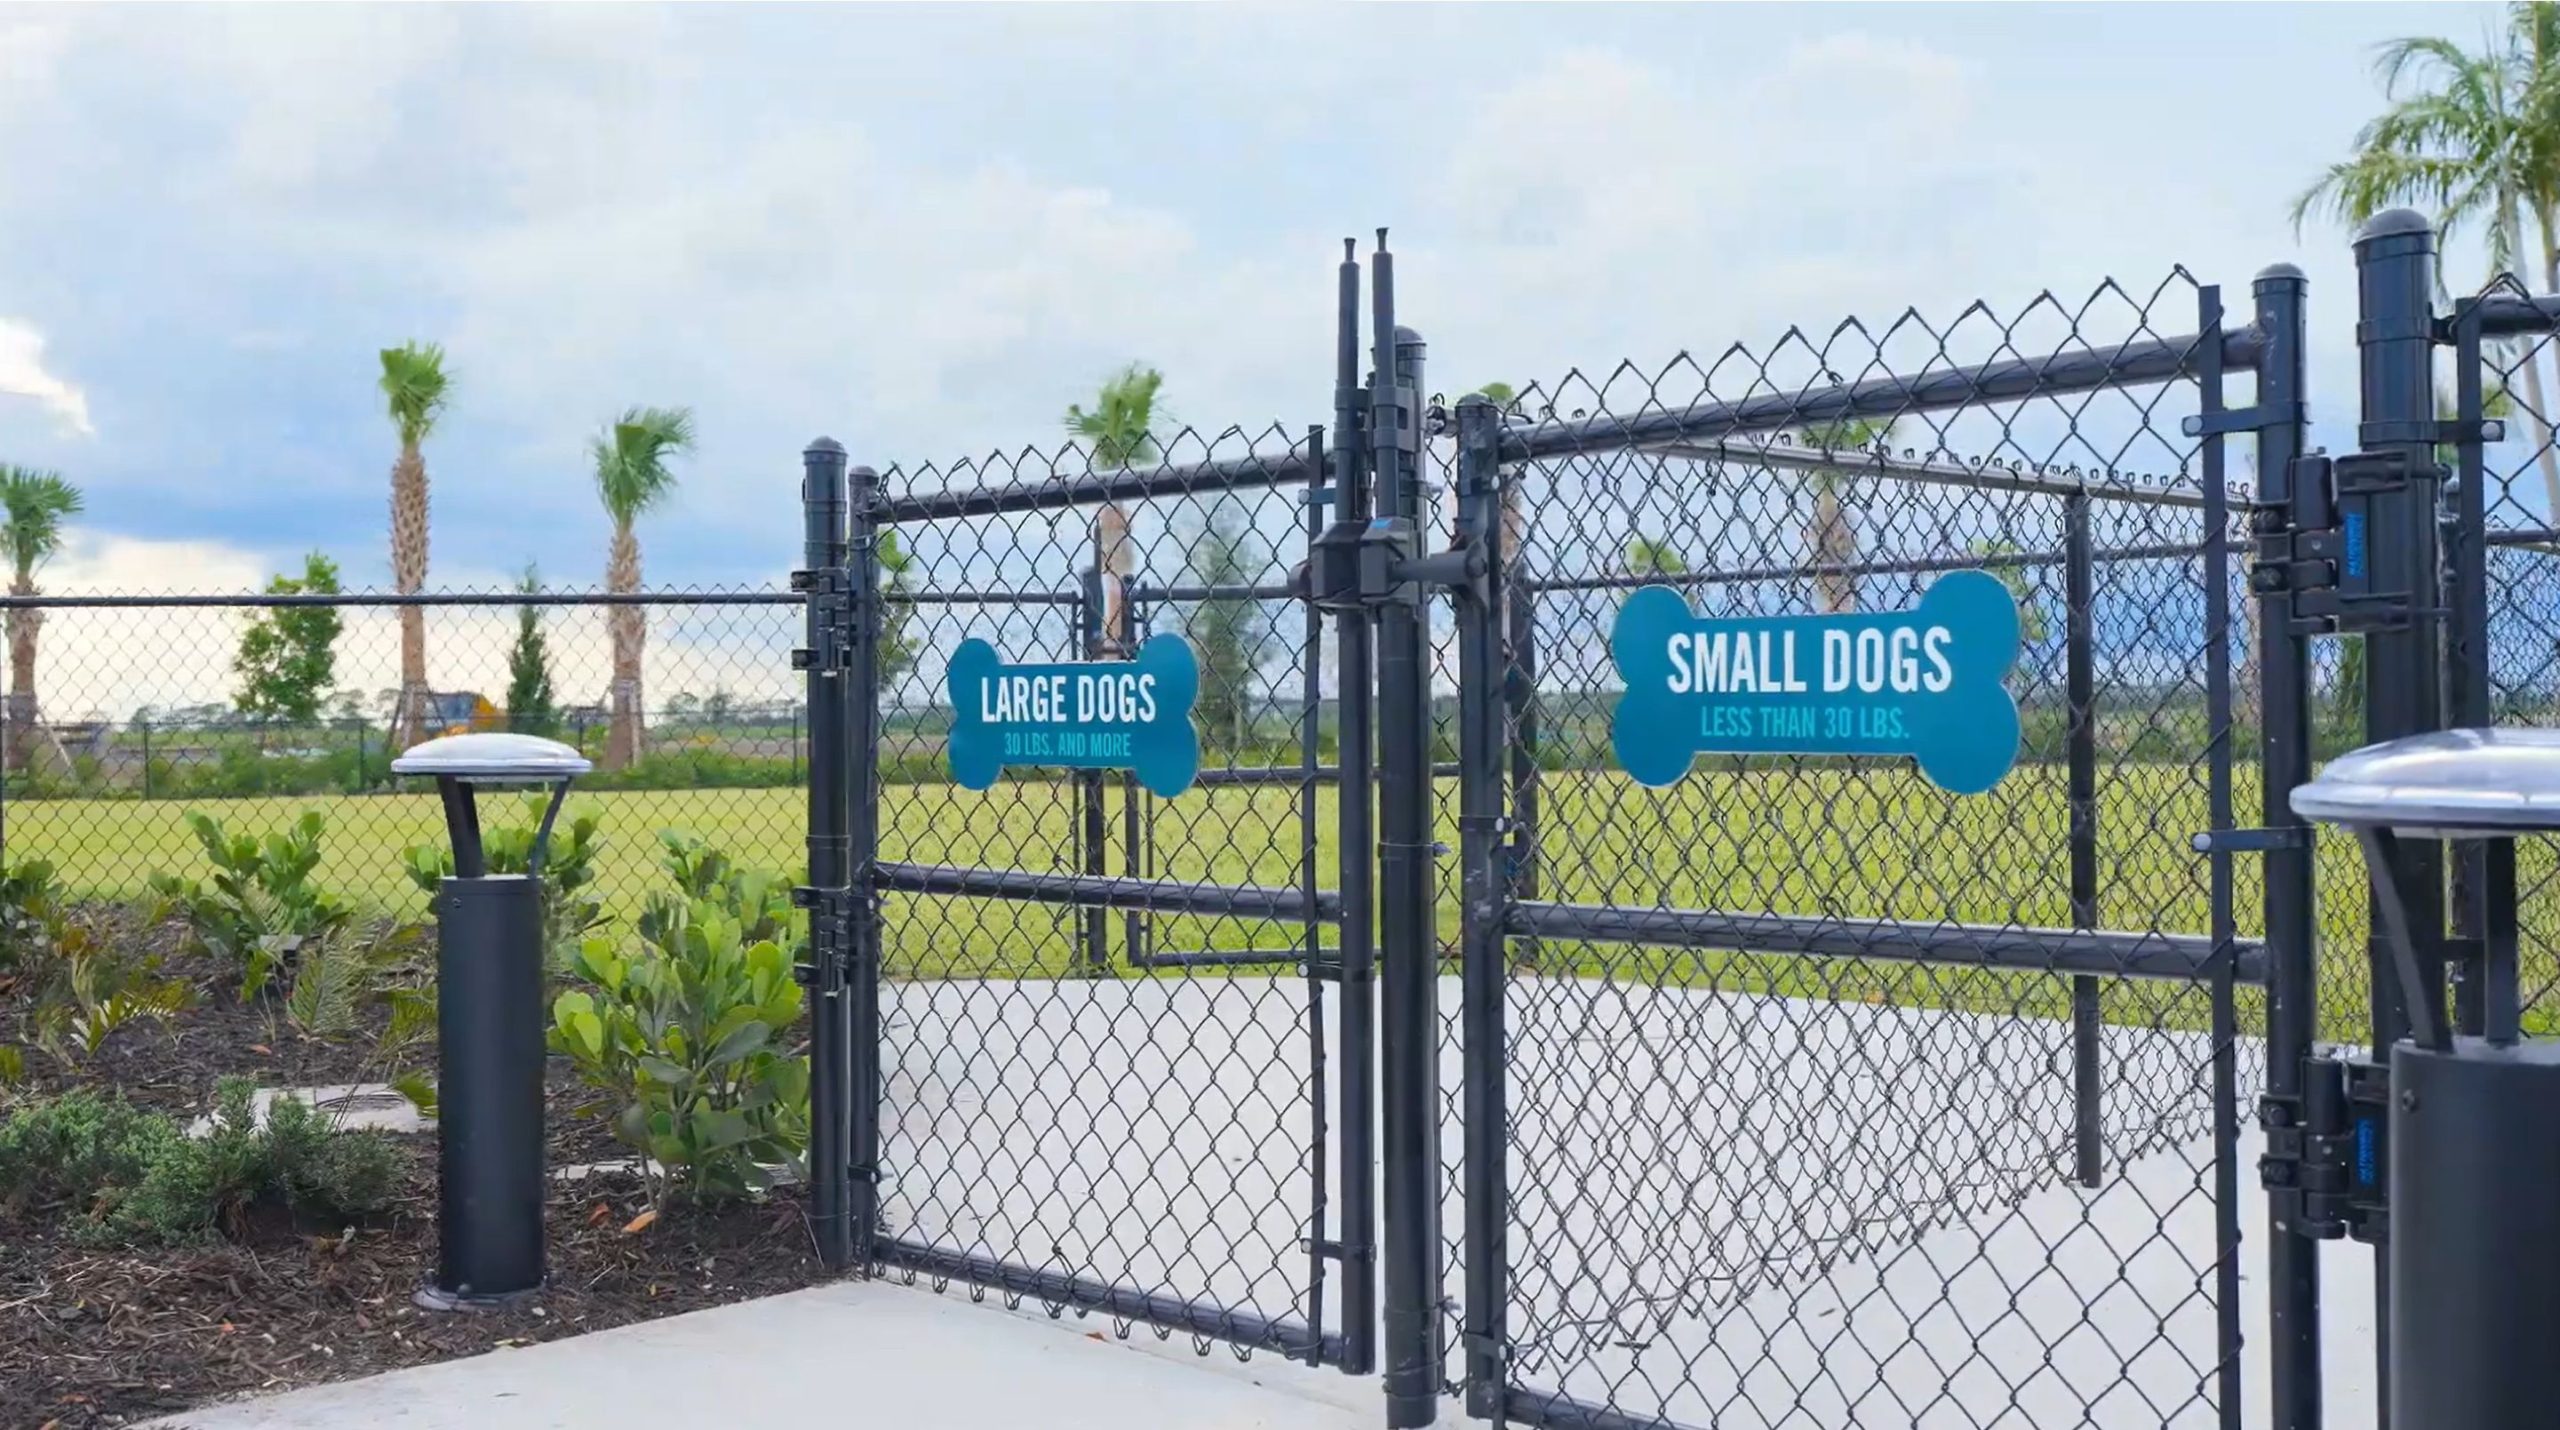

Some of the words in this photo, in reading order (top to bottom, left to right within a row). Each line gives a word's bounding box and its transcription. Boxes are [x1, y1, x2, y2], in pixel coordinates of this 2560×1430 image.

[1667, 630, 1806, 693] SMALL
[1823, 626, 1952, 693] DOGS
[981, 676, 1067, 723] LARGE
[1078, 674, 1156, 723] DOGS
[1702, 706, 1752, 737] LESS
[1760, 707, 1815, 738] THAN
[1824, 708, 1852, 739] 30
[1859, 708, 1910, 739] LBS.
[1004, 732, 1020, 756] 30
[1024, 732, 1054, 756] LBS.
[1058, 732, 1086, 757] AND
[1090, 733, 1132, 756] MORE
